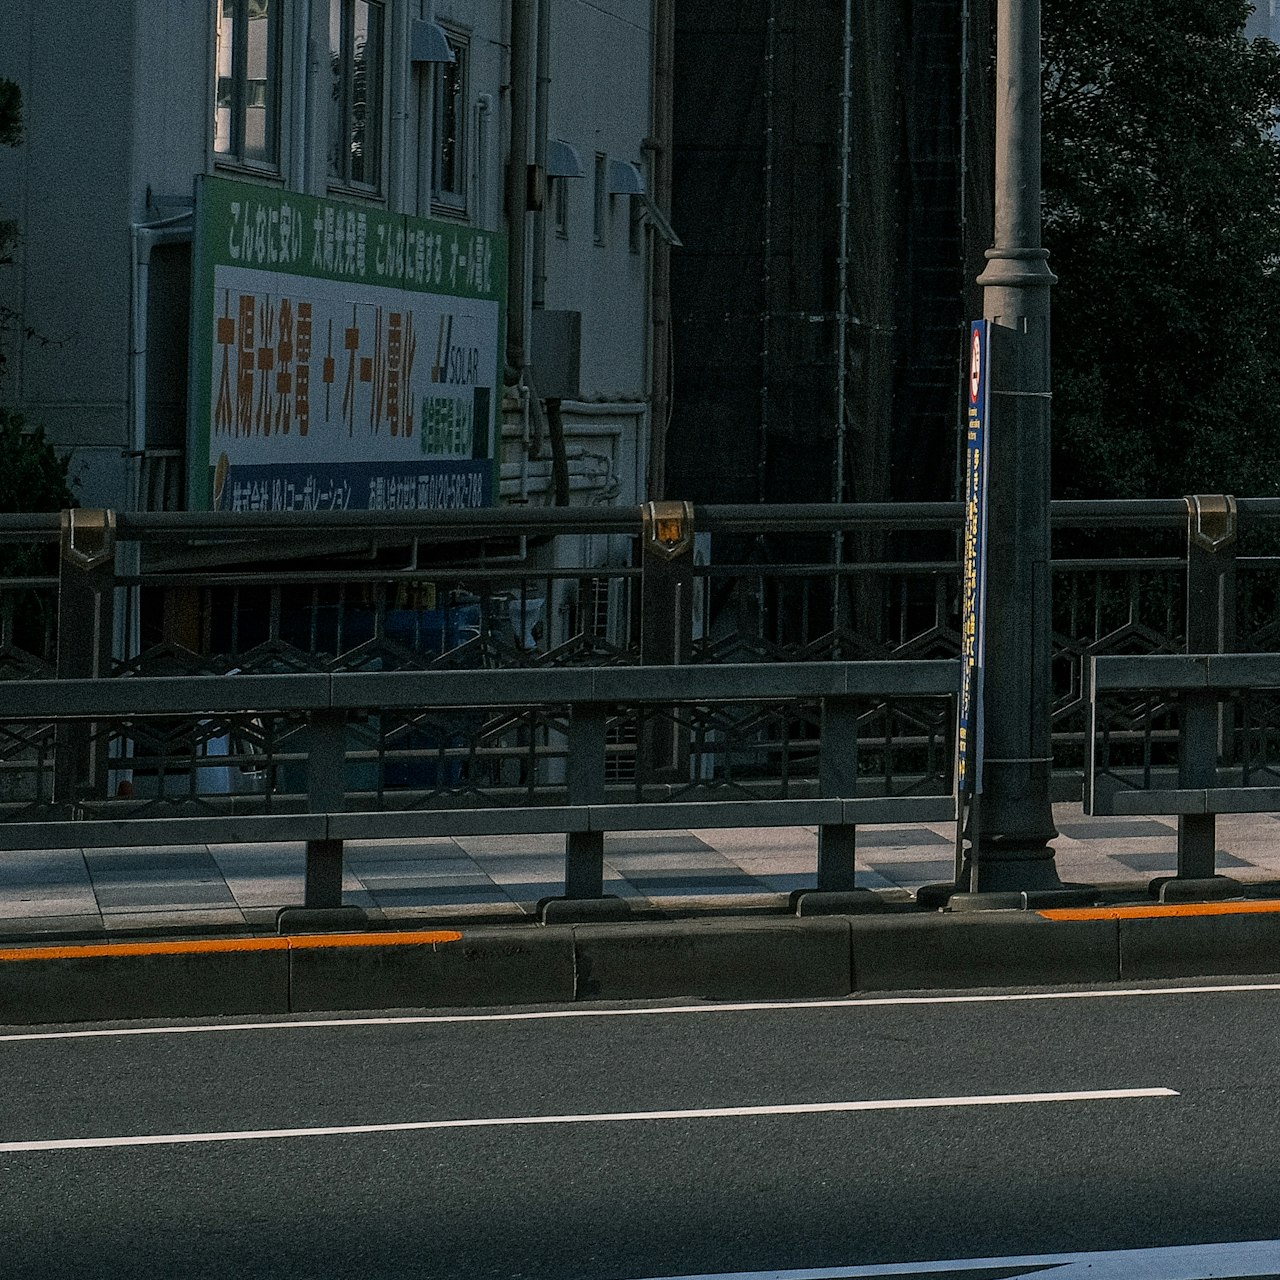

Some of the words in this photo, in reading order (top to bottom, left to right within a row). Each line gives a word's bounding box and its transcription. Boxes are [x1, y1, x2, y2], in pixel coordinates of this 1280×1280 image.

[228, 201, 303, 264] こんなに安い
[311, 203, 367, 277] 太陽光発電
[449, 232, 492, 293] オール電化
[449, 345, 479, 385] SOLAR
